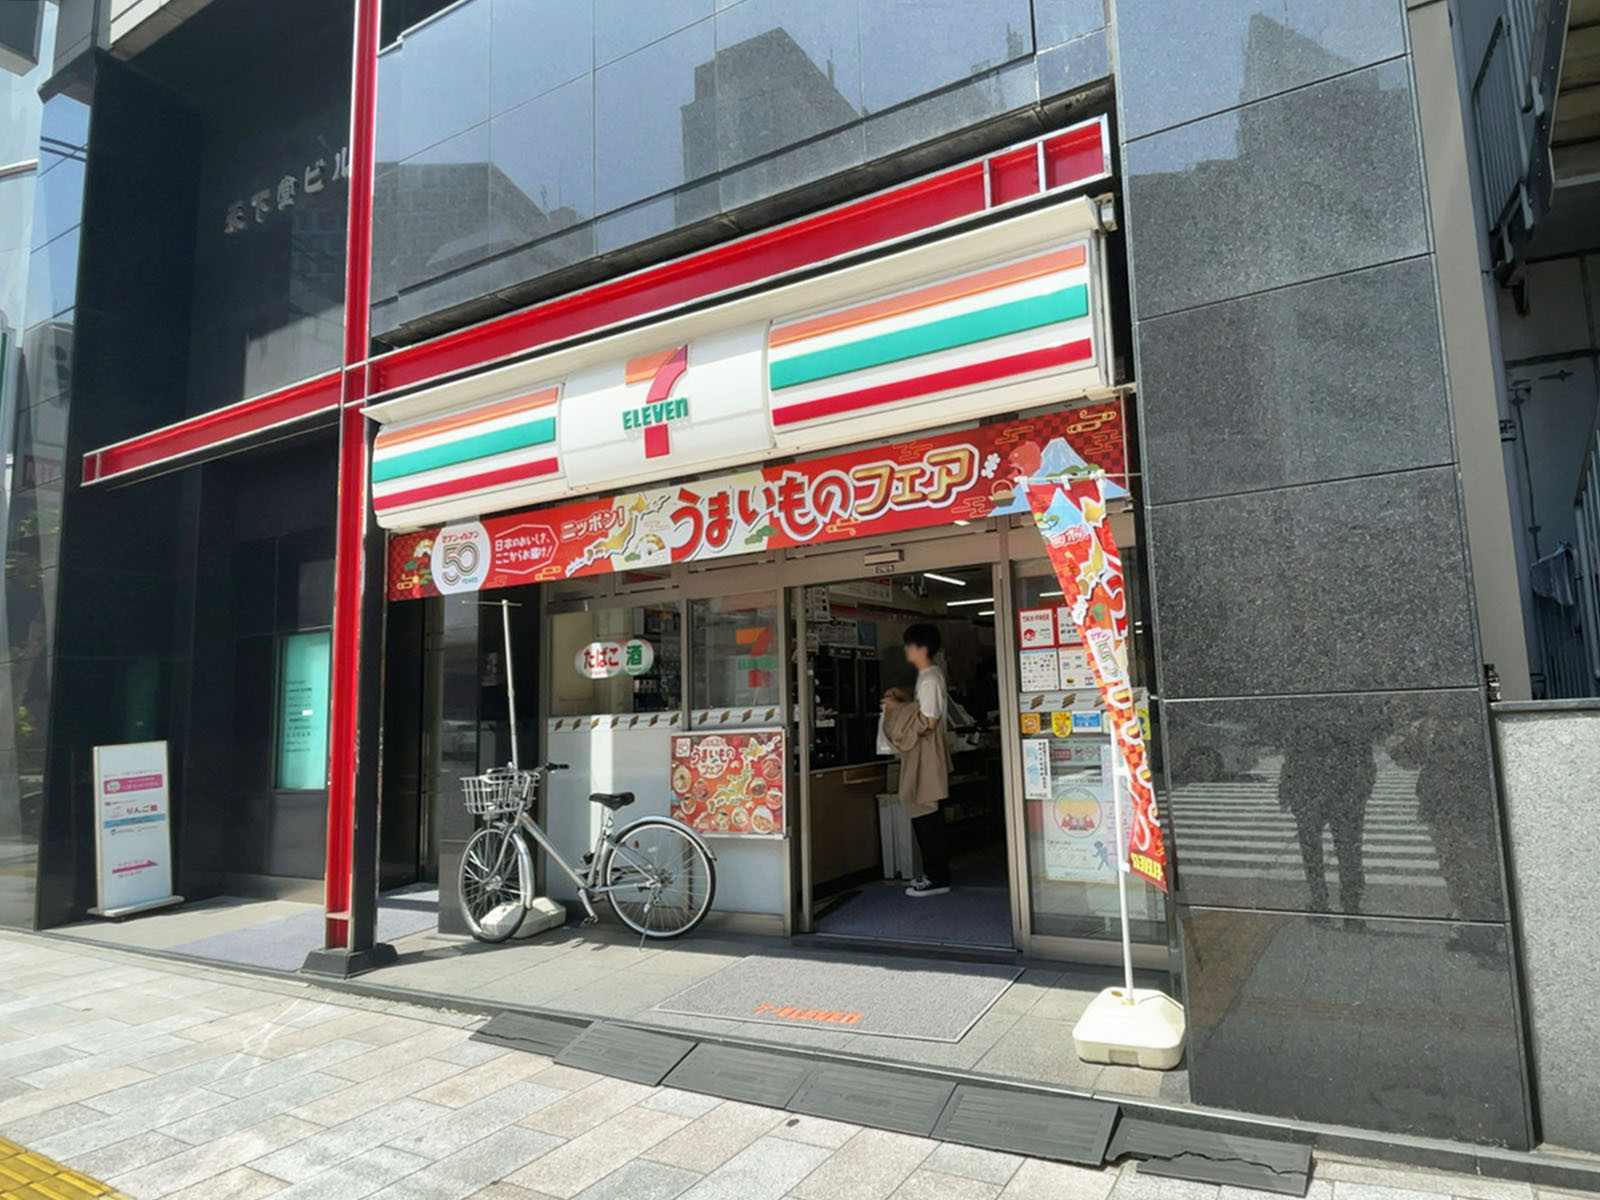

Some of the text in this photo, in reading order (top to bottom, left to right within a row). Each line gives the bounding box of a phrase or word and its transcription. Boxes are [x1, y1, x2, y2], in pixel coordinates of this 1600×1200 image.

[625, 344, 688, 458] 7
[561, 509, 625, 541] ニッポン!
[442, 541, 480, 586] 50
[583, 647, 619, 669] たばこ
[626, 644, 643, 666] 酒
